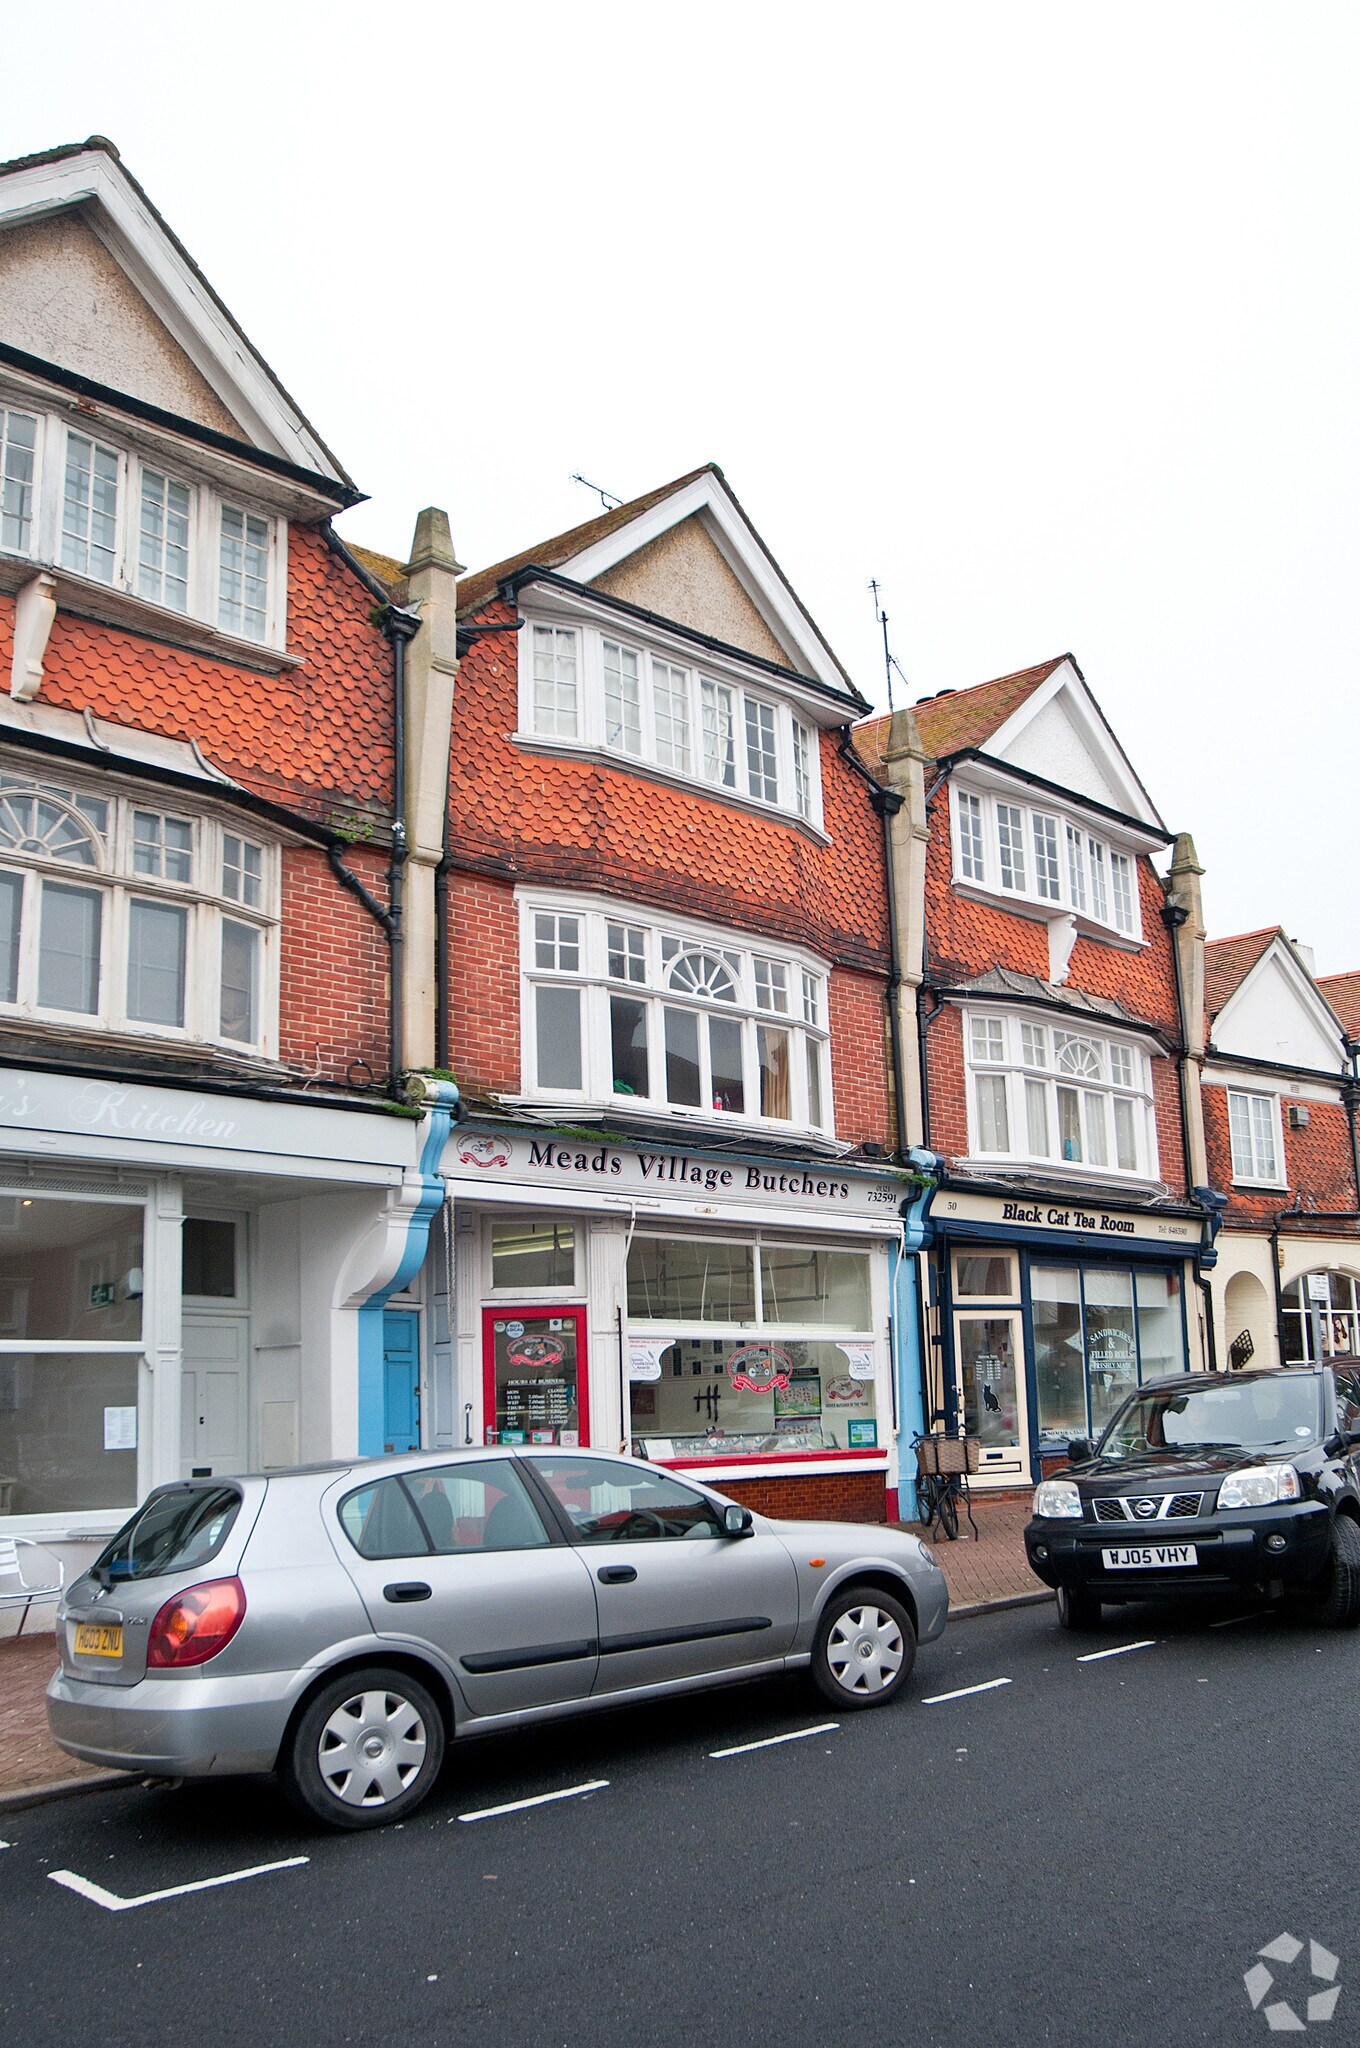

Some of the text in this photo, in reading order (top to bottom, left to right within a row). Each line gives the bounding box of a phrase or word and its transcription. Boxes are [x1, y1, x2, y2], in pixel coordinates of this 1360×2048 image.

[69, 1082, 242, 1139] Kitchen
[528, 1140, 850, 1200] Meads Village Butchers
[866, 1192, 897, 1204] 732591
[946, 1202, 958, 1210] 50
[1002, 1203, 1135, 1233] Black Cat Tea Room
[1090, 1328, 1132, 1344] SANDWICHES
[1108, 1336, 1116, 1349] &
[1091, 1350, 1114, 1358] FILLED
[1109, 1547, 1188, 1564] WJ05 VHY
[101, 1629, 120, 1651] ZNU
